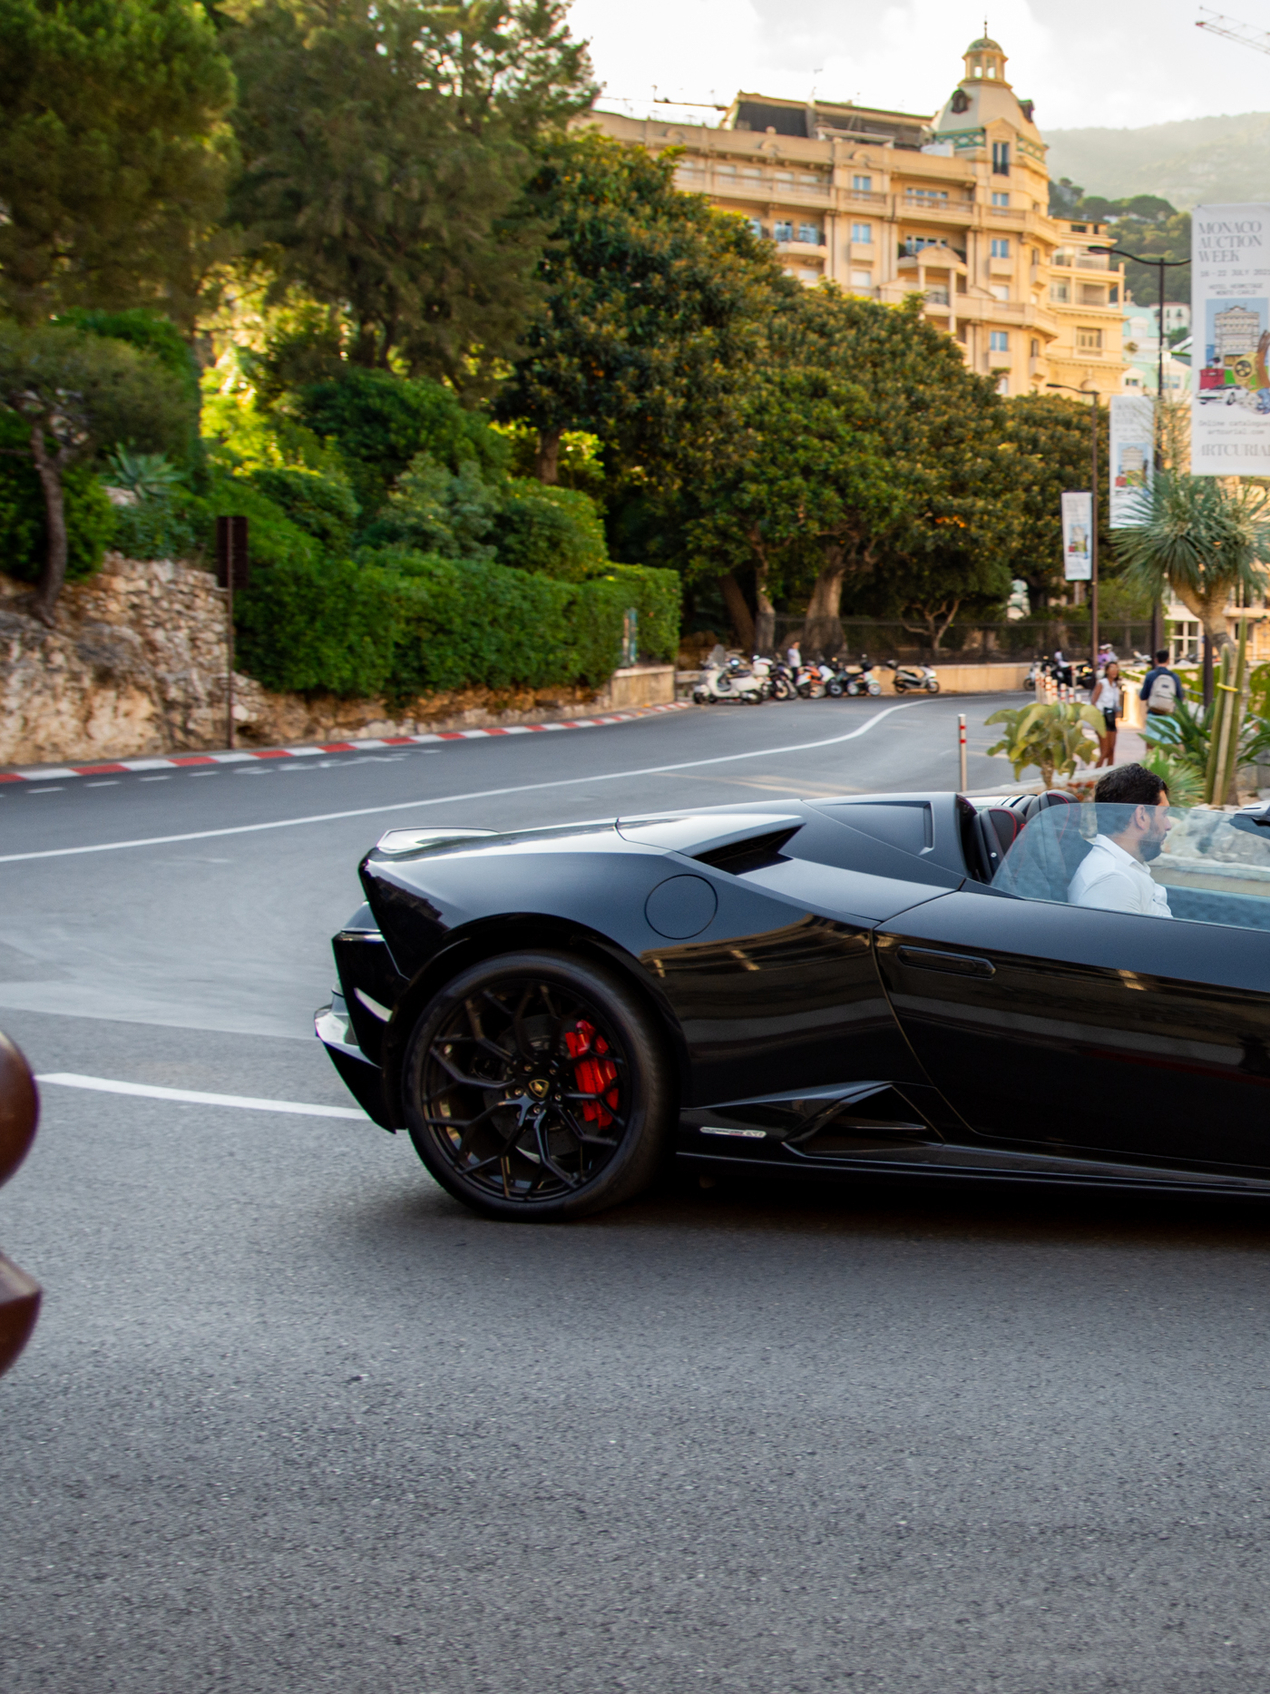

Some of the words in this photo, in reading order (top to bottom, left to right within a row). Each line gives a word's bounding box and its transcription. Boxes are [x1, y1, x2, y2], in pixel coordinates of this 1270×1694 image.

[1198, 221, 1262, 235] MONACO
[1198, 235, 1263, 249] AUCTION
[1198, 249, 1240, 263] WEEK
